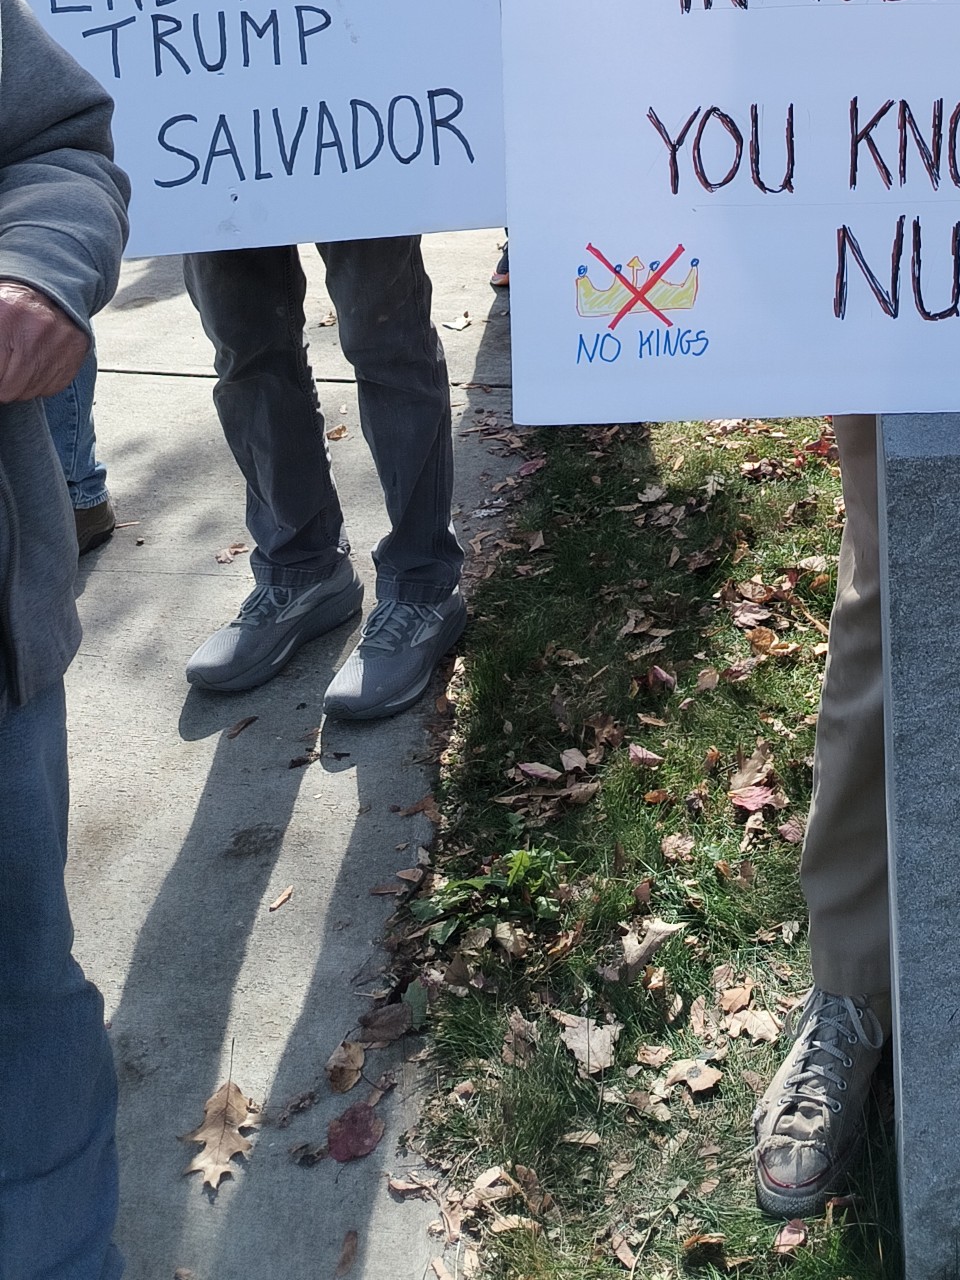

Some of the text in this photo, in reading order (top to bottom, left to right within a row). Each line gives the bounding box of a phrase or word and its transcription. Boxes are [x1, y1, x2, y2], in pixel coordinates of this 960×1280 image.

[82, 5, 332, 79] TRUMP
[154, 87, 476, 188] SALVADOR
[646, 102, 795, 195] YOU
[576, 327, 710, 365] NO KINGS
